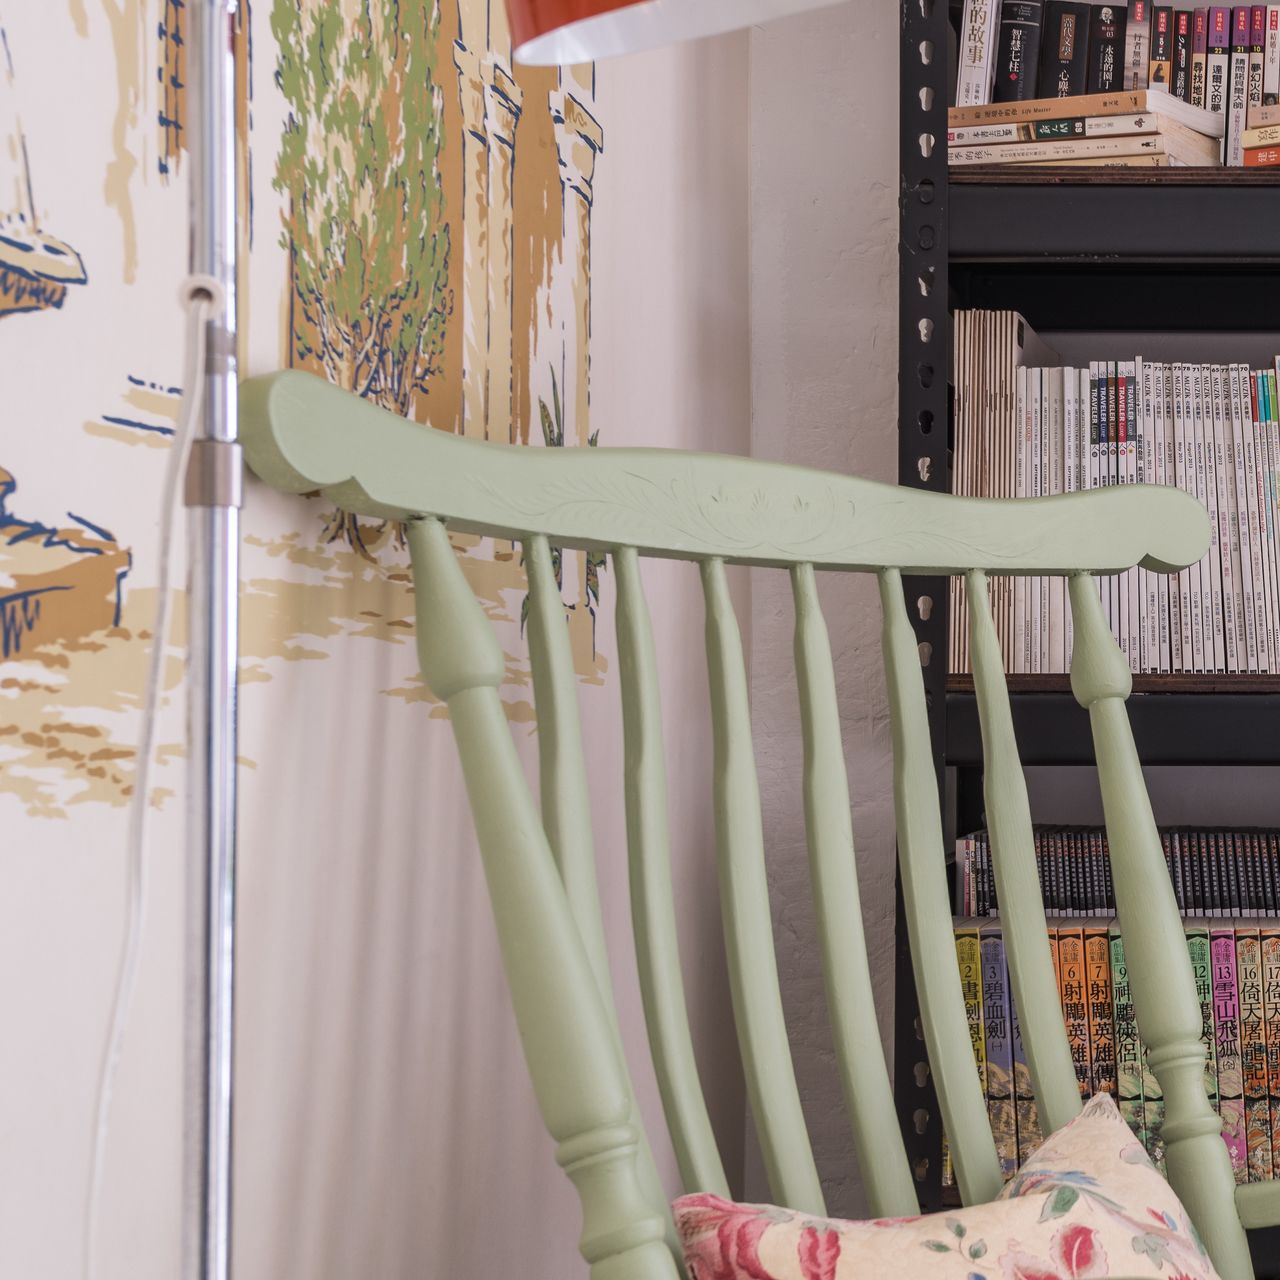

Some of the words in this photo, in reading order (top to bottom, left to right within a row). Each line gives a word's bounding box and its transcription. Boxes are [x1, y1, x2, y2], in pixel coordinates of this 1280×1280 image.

[1210, 64, 1223, 113] 達爾文的夢
[1250, 63, 1262, 102] 夢幻火焰
[989, 966, 997, 979] 3
[1095, 966, 1102, 980] 7
[1217, 965, 1232, 980] 13
[1243, 966, 1256, 980] 16
[1268, 966, 1280, 980] 17
[984, 983, 1007, 1040] 碧血劍
[1215, 982, 1239, 1058] 雪山飛狐
[1240, 981, 1265, 1081] 倚天屠龍記
